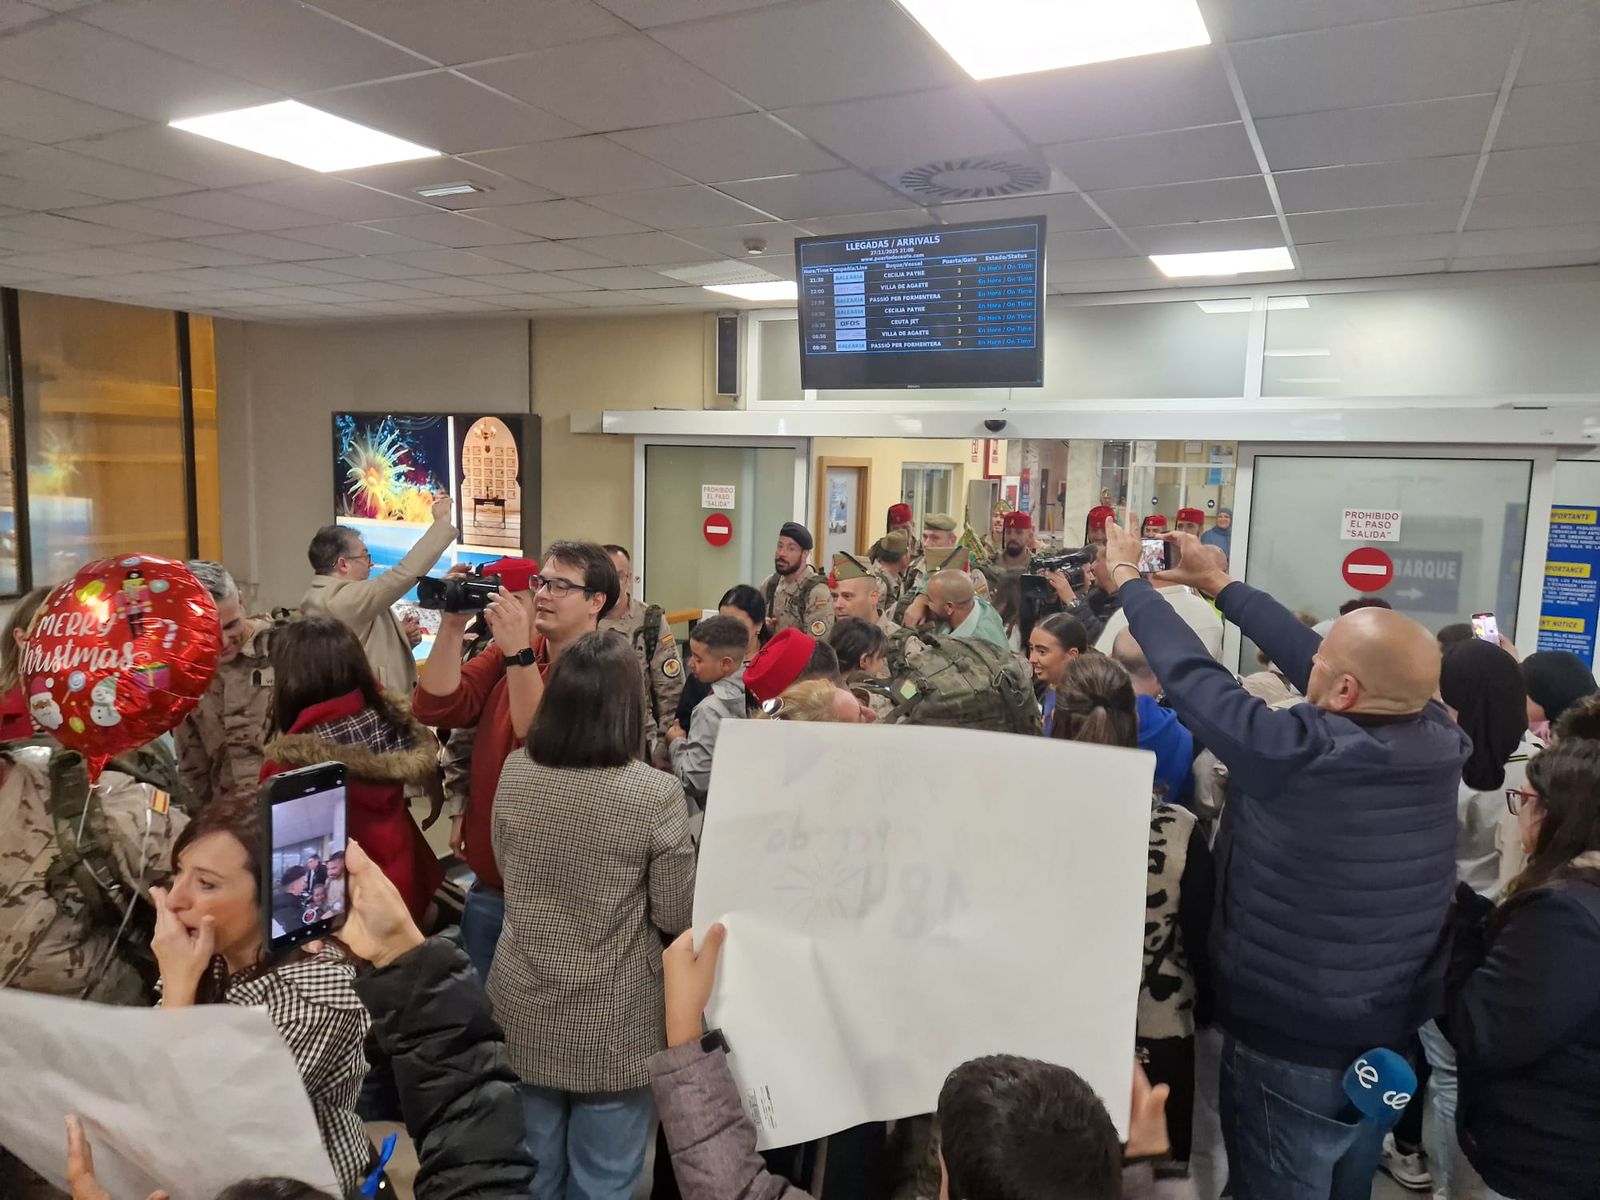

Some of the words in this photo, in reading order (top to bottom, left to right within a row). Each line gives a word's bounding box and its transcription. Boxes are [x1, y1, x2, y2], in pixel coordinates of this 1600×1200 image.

[845, 240, 889, 251] LLEGADAS
[891, 240, 895, 248] /
[896, 235, 940, 247] ARRIVALS
[885, 260, 923, 269] Buque/Vessel
[1345, 510, 1399, 521] PROHIBIDO
[1350, 520, 1362, 528] EL
[1365, 520, 1392, 529] PASO
[1346, 530, 1392, 539] "SALIDA"
[18, 639, 151, 675] Christmas
